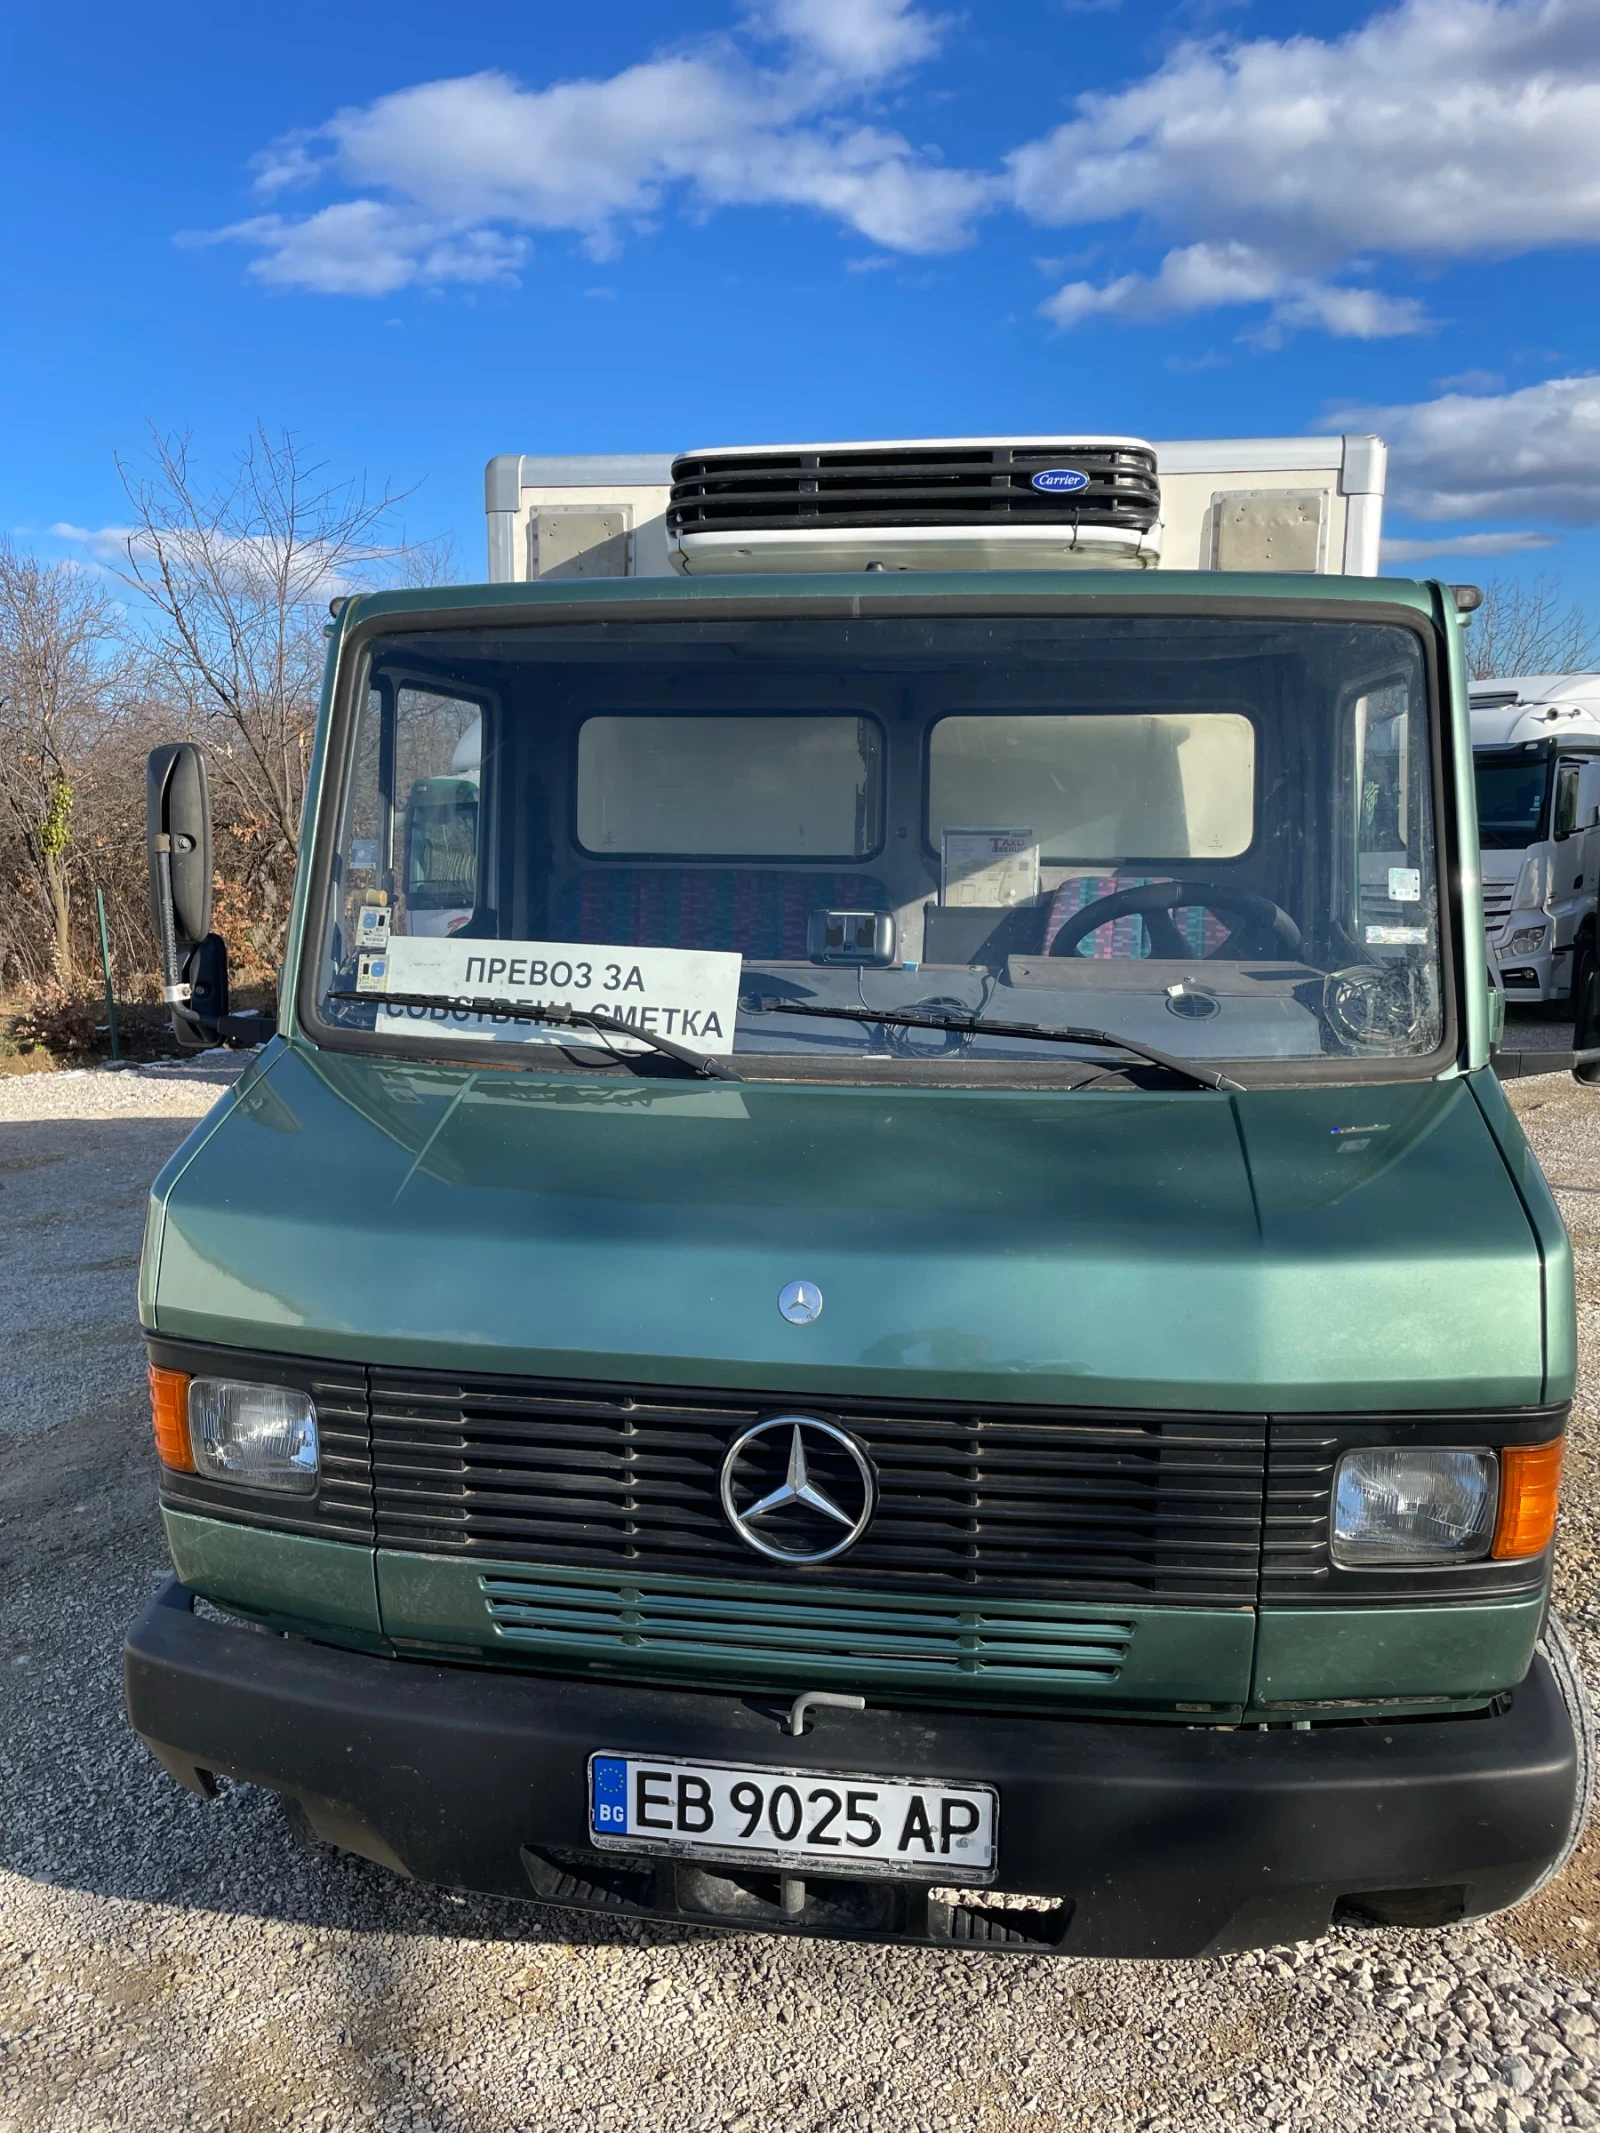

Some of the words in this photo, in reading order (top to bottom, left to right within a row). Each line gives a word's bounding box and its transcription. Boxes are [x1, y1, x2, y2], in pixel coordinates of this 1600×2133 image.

[1038, 474, 1081, 485] Carrier
[464, 956, 592, 989] ПРЕВОЗ
[602, 963, 646, 993] ЗА
[385, 990, 577, 1028] СОБСТВЕ
[599, 1803, 625, 1824] BG
[635, 1770, 715, 1833] EB
[729, 1780, 882, 1848] 9025
[898, 1794, 981, 1855] AP
